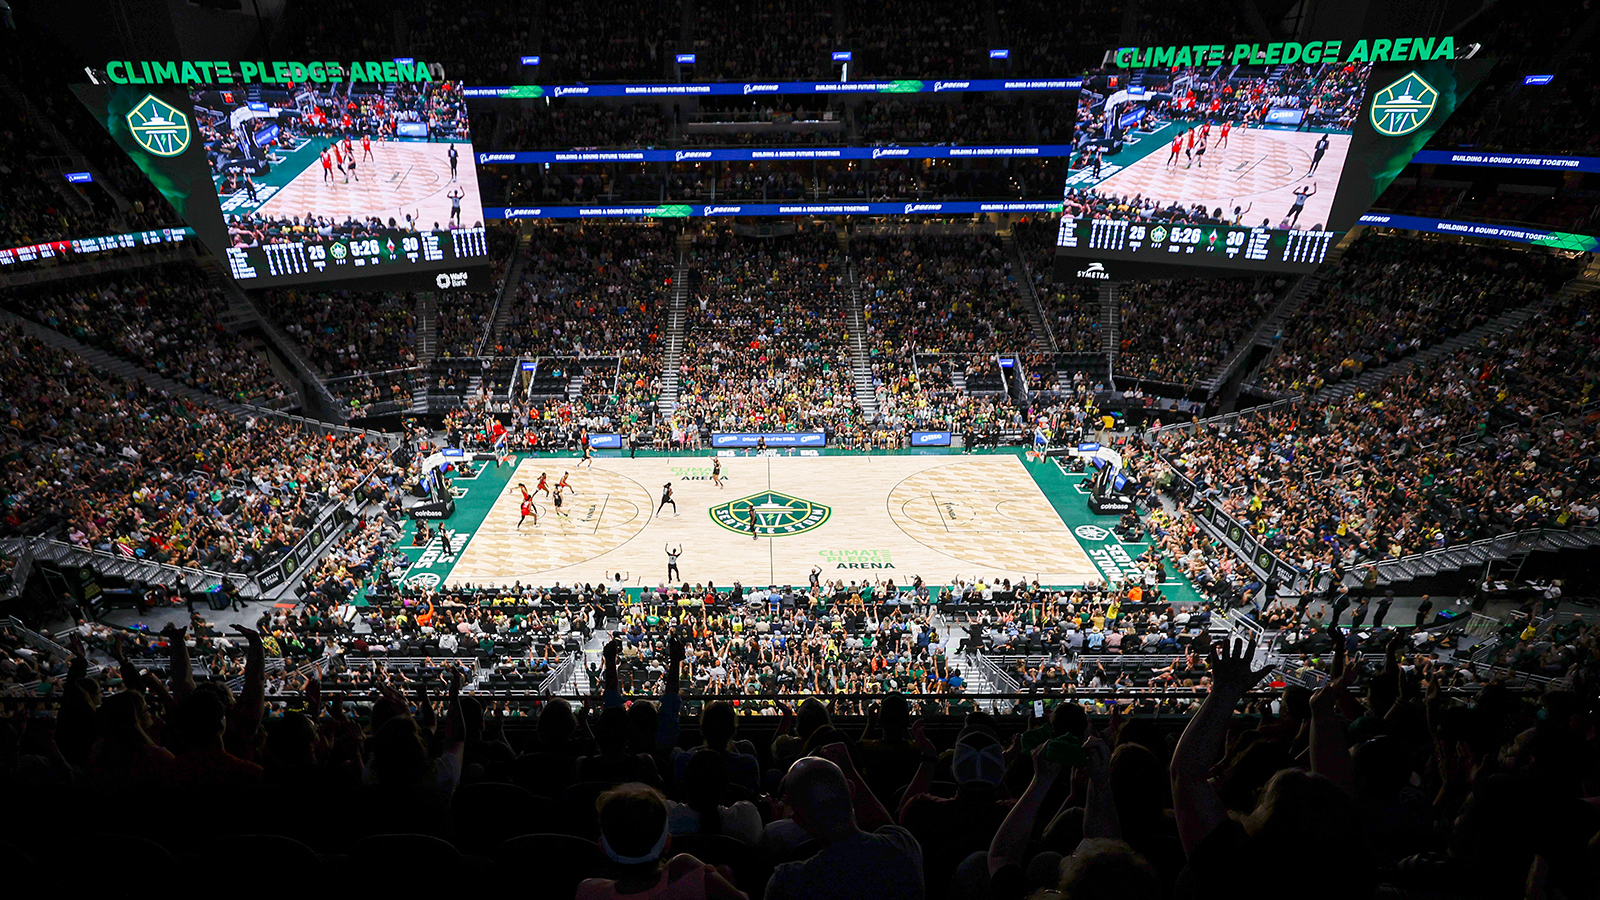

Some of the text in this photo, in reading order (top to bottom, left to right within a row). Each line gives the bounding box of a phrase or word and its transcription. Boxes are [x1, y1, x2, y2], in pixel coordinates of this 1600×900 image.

[1115, 36, 1455, 69] CLIMATE PLEDGE ARENA
[105, 60, 433, 85] CLIMATE PLEDGE ARENA
[1542, 159, 1580, 167] TOGETHER
[1359, 215, 1391, 223] OEING
[1128, 225, 1147, 241] 25
[1169, 227, 1202, 244] 5:26
[1437, 222, 1468, 232] BUILDING
[1475, 227, 1499, 235] SOUND
[1499, 230, 1525, 238] FUTURE
[402, 237, 419, 252] 30
[1225, 231, 1246, 247] 30
[307, 245, 326, 260] 25
[349, 239, 380, 257] 5:26
[449, 272, 468, 281] WaFd
[451, 279, 467, 287] Bank
[1076, 271, 1109, 280] SYMETRA
[591, 436, 613, 444] OREO
[717, 435, 738, 443] OREO
[800, 435, 821, 443] OREO
[920, 433, 943, 442] OREO
[784, 508, 824, 533] STORM
[437, 533, 470, 563] SORM
[1088, 549, 1124, 582] STORM
